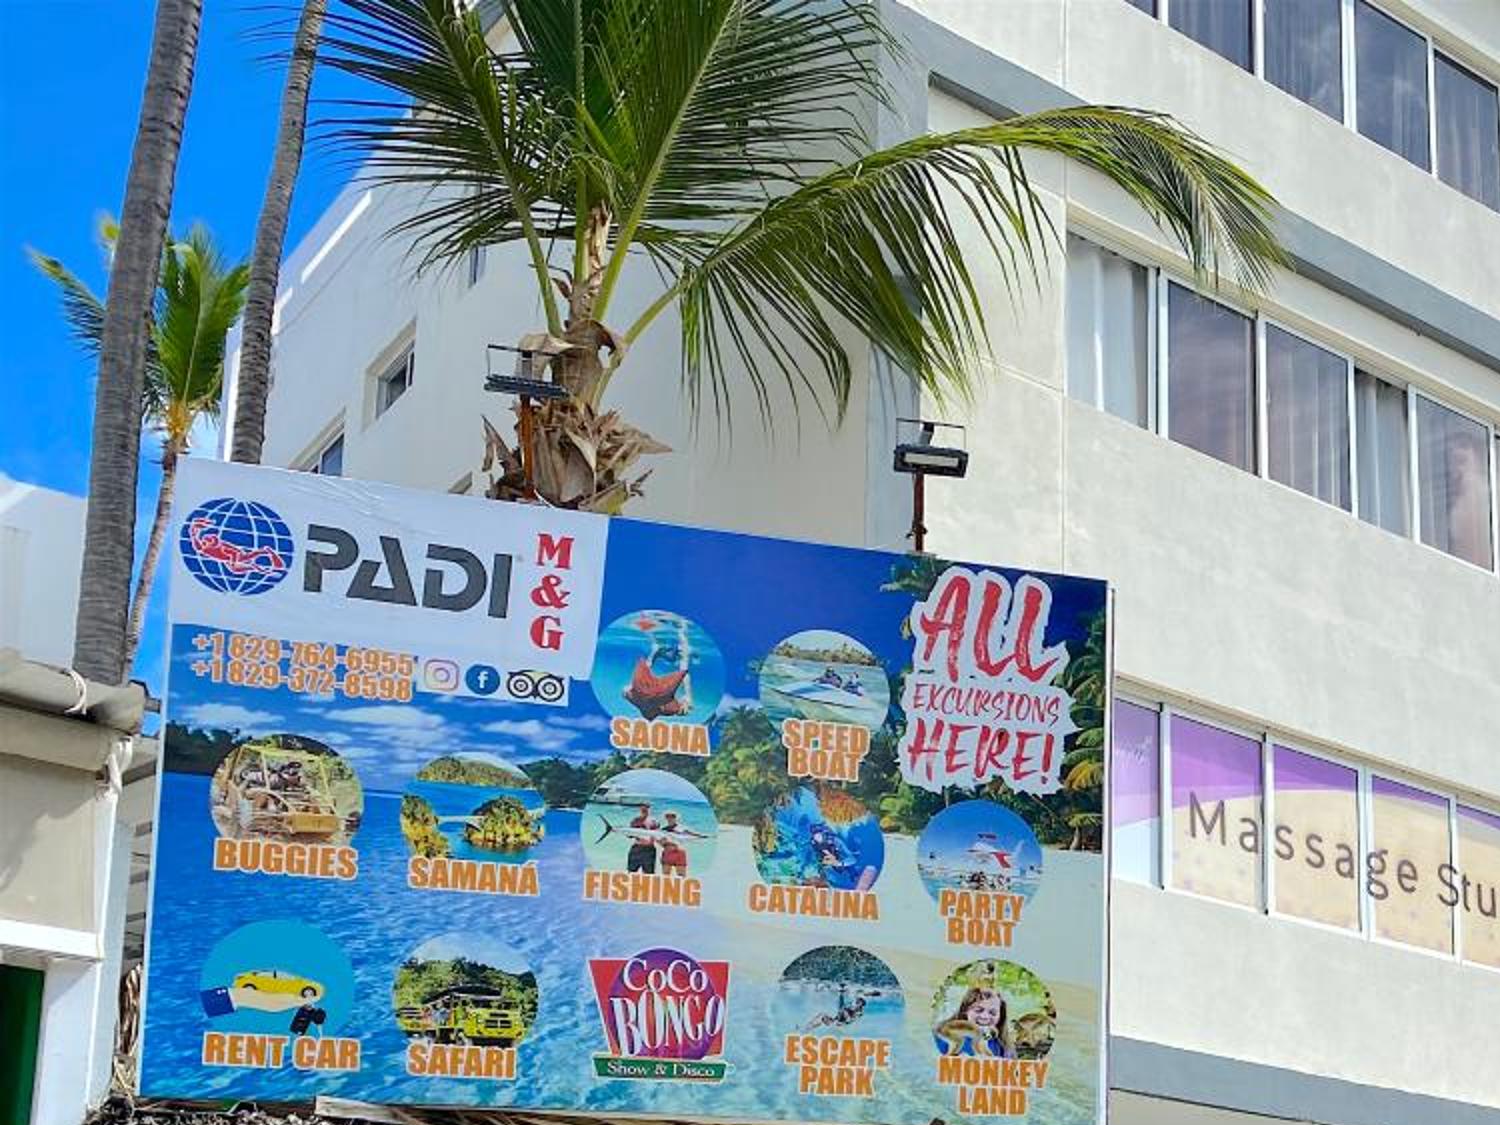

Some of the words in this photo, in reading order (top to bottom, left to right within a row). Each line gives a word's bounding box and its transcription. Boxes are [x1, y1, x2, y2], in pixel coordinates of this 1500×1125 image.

[536, 533, 575, 570] M
[303, 524, 512, 618] PADI
[530, 574, 570, 609] &
[530, 615, 564, 652] G
[920, 574, 1060, 682] ALL
[228, 634, 414, 676] 829-764-6955
[227, 659, 412, 702] 829-372-8598
[912, 681, 1061, 724] EXCURSIONS
[611, 719, 710, 756] SAONA
[783, 720, 870, 756] SPEED
[907, 718, 1055, 783] HERE!
[788, 749, 863, 782] BOAT
[214, 837, 357, 880] BUGGIES
[1188, 791, 1418, 900] Massage
[409, 857, 539, 895] SAMANÁ
[584, 870, 701, 907] FISHING
[748, 883, 879, 921] CATALINA
[939, 888, 1024, 921] PARTY
[946, 917, 1015, 947] BOAT
[610, 990, 725, 1057] BONGO
[203, 1032, 289, 1068] RENT
[294, 1036, 360, 1071] CAR
[407, 1046, 517, 1079] SAFARI
[607, 1061, 650, 1075] Show
[655, 1063, 667, 1075] &
[673, 1063, 715, 1077] Disco
[786, 1036, 890, 1068] ESCAPE
[800, 1066, 875, 1097] PARK
[938, 1055, 1048, 1088] MONKEY
[959, 1086, 1031, 1116] LAND
